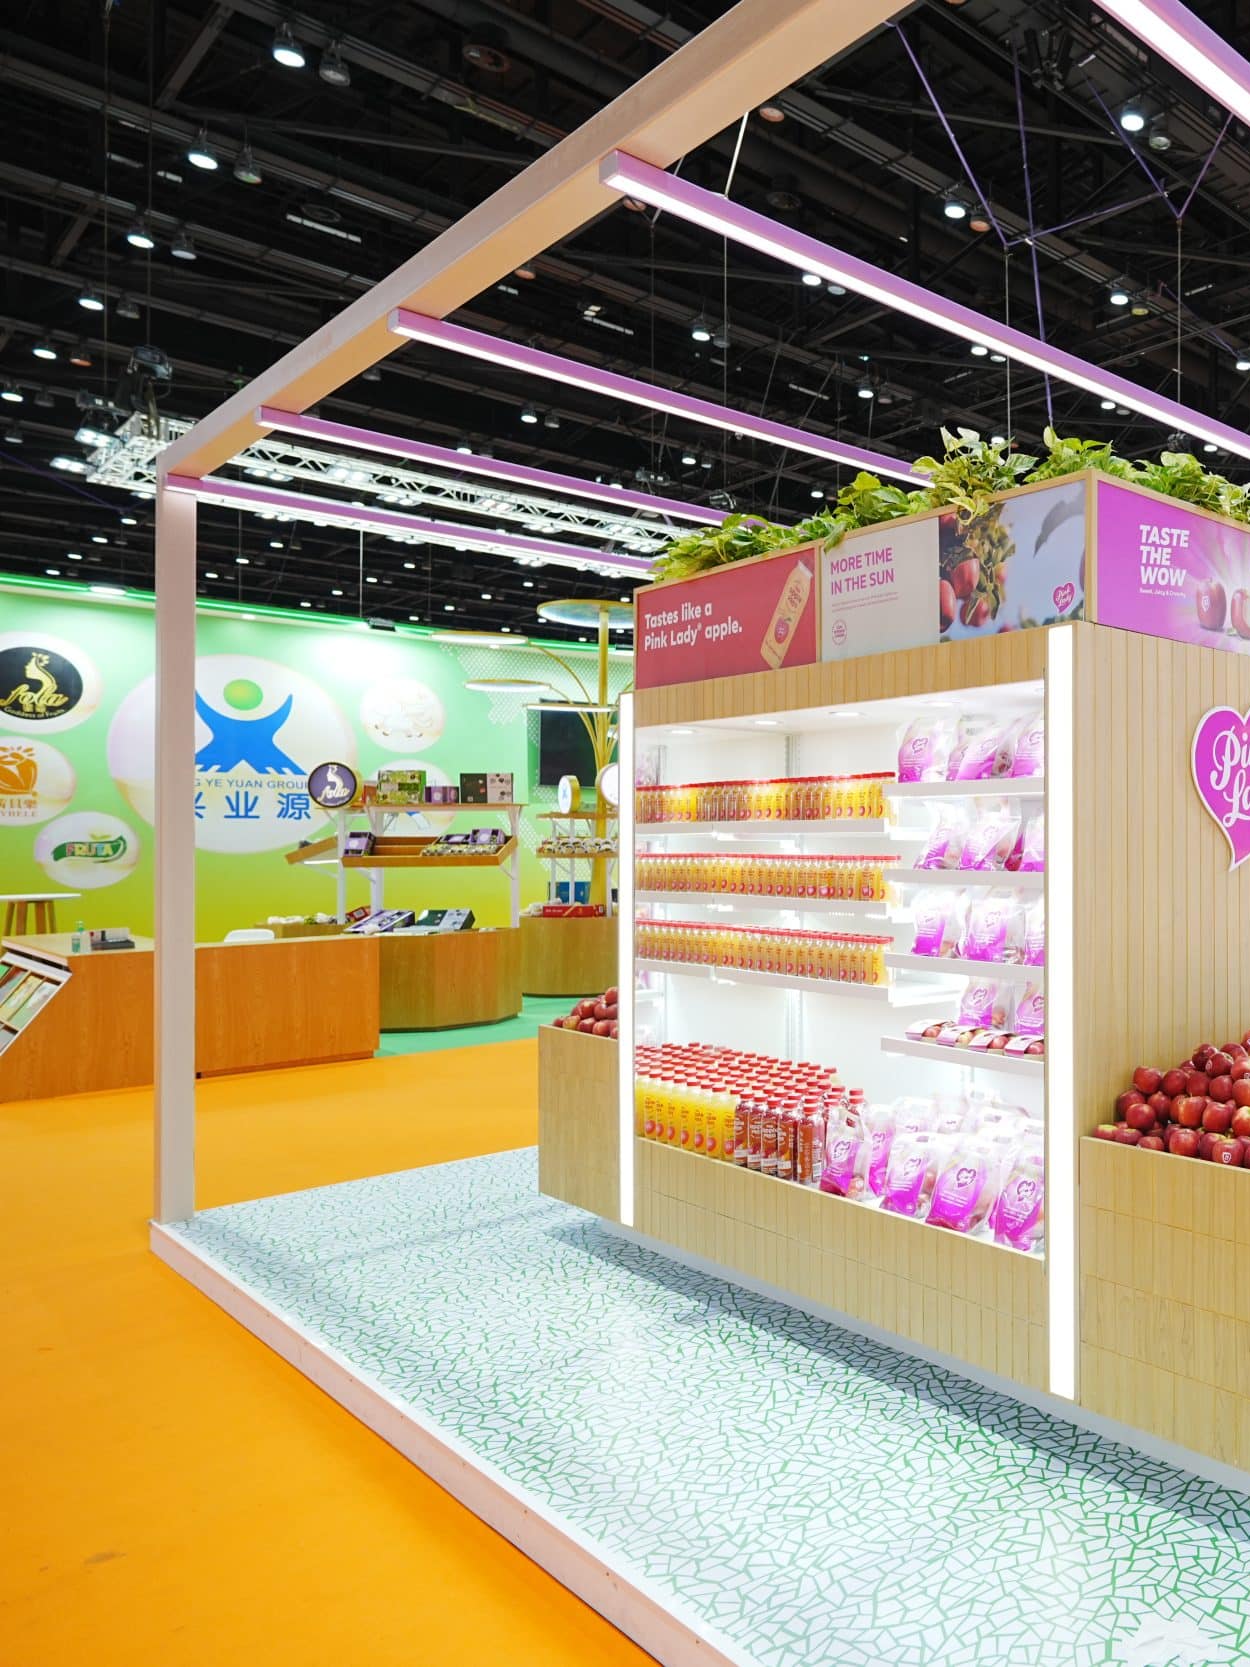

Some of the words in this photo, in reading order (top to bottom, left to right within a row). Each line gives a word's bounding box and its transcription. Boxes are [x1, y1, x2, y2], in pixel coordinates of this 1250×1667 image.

[1139, 524, 1190, 548] TASTE
[830, 554, 863, 575] MORE
[864, 547, 893, 567] TIME
[1139, 545, 1172, 566] THE
[831, 579, 843, 596] IN
[845, 574, 867, 593] THE
[869, 568, 895, 587] SUN
[1140, 565, 1187, 587] WOW
[644, 610, 679, 630] Tastes
[681, 602, 702, 622] like
[704, 602, 712, 616] a
[644, 630, 667, 651] Pink
[704, 616, 743, 643] apple.
[206, 779, 222, 788] YE
[227, 779, 263, 790] YUAN
[267, 780, 309, 790] GROU
[66, 843, 113, 858] FRUTA
